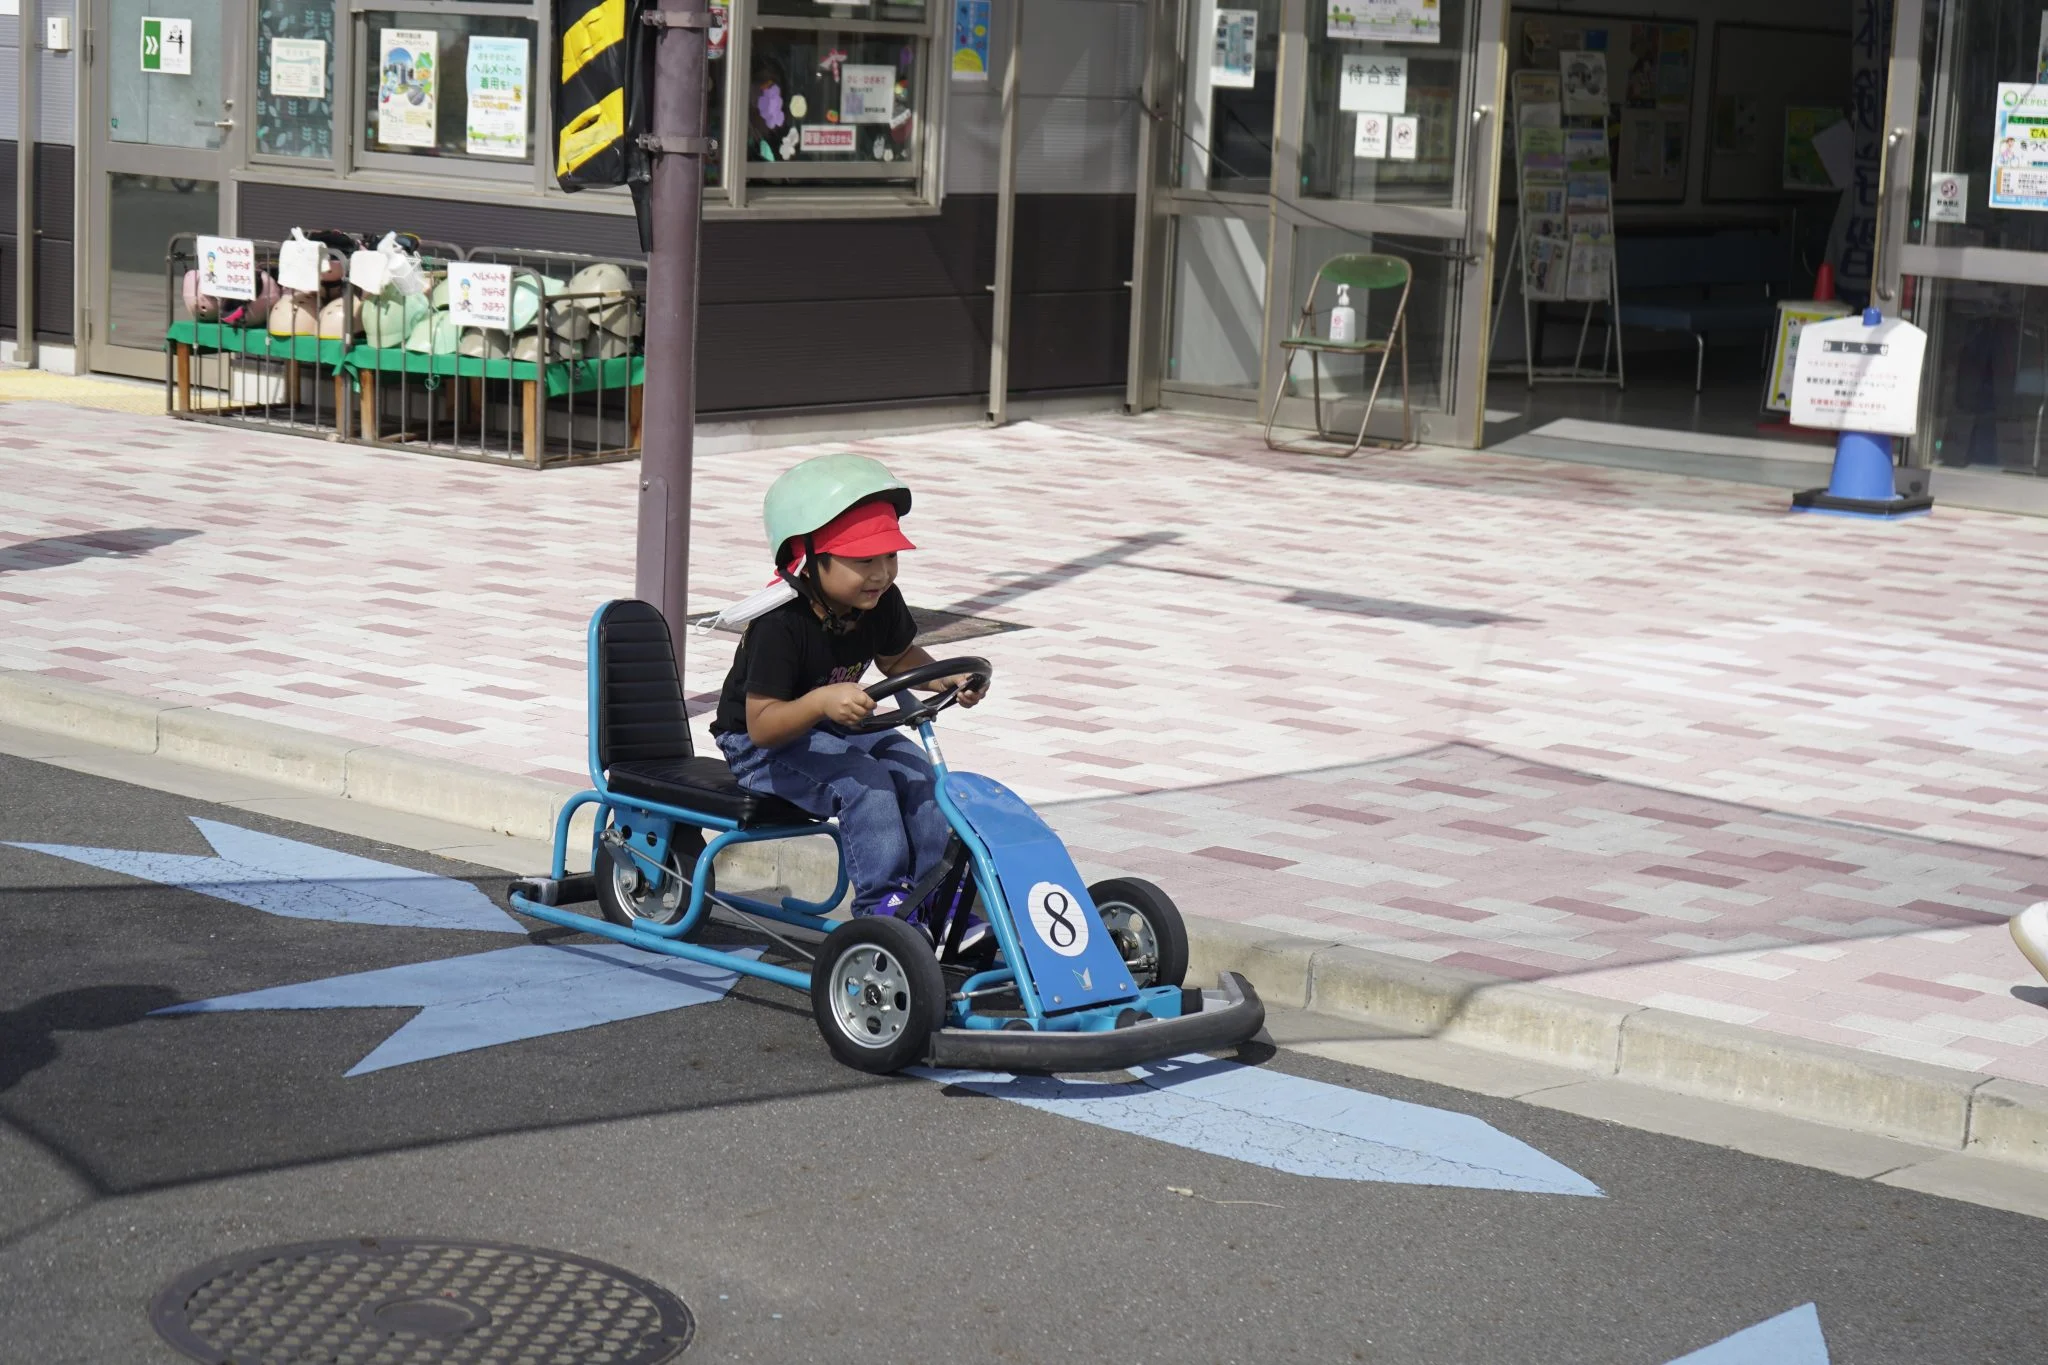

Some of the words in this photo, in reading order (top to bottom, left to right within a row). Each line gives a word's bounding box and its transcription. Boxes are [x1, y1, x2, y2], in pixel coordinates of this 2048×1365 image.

[472, 63, 521, 76] ヘルメットの
[1348, 63, 1401, 86] 待合室
[1823, 340, 1888, 356] おしらせ
[1044, 892, 1076, 947] 8
